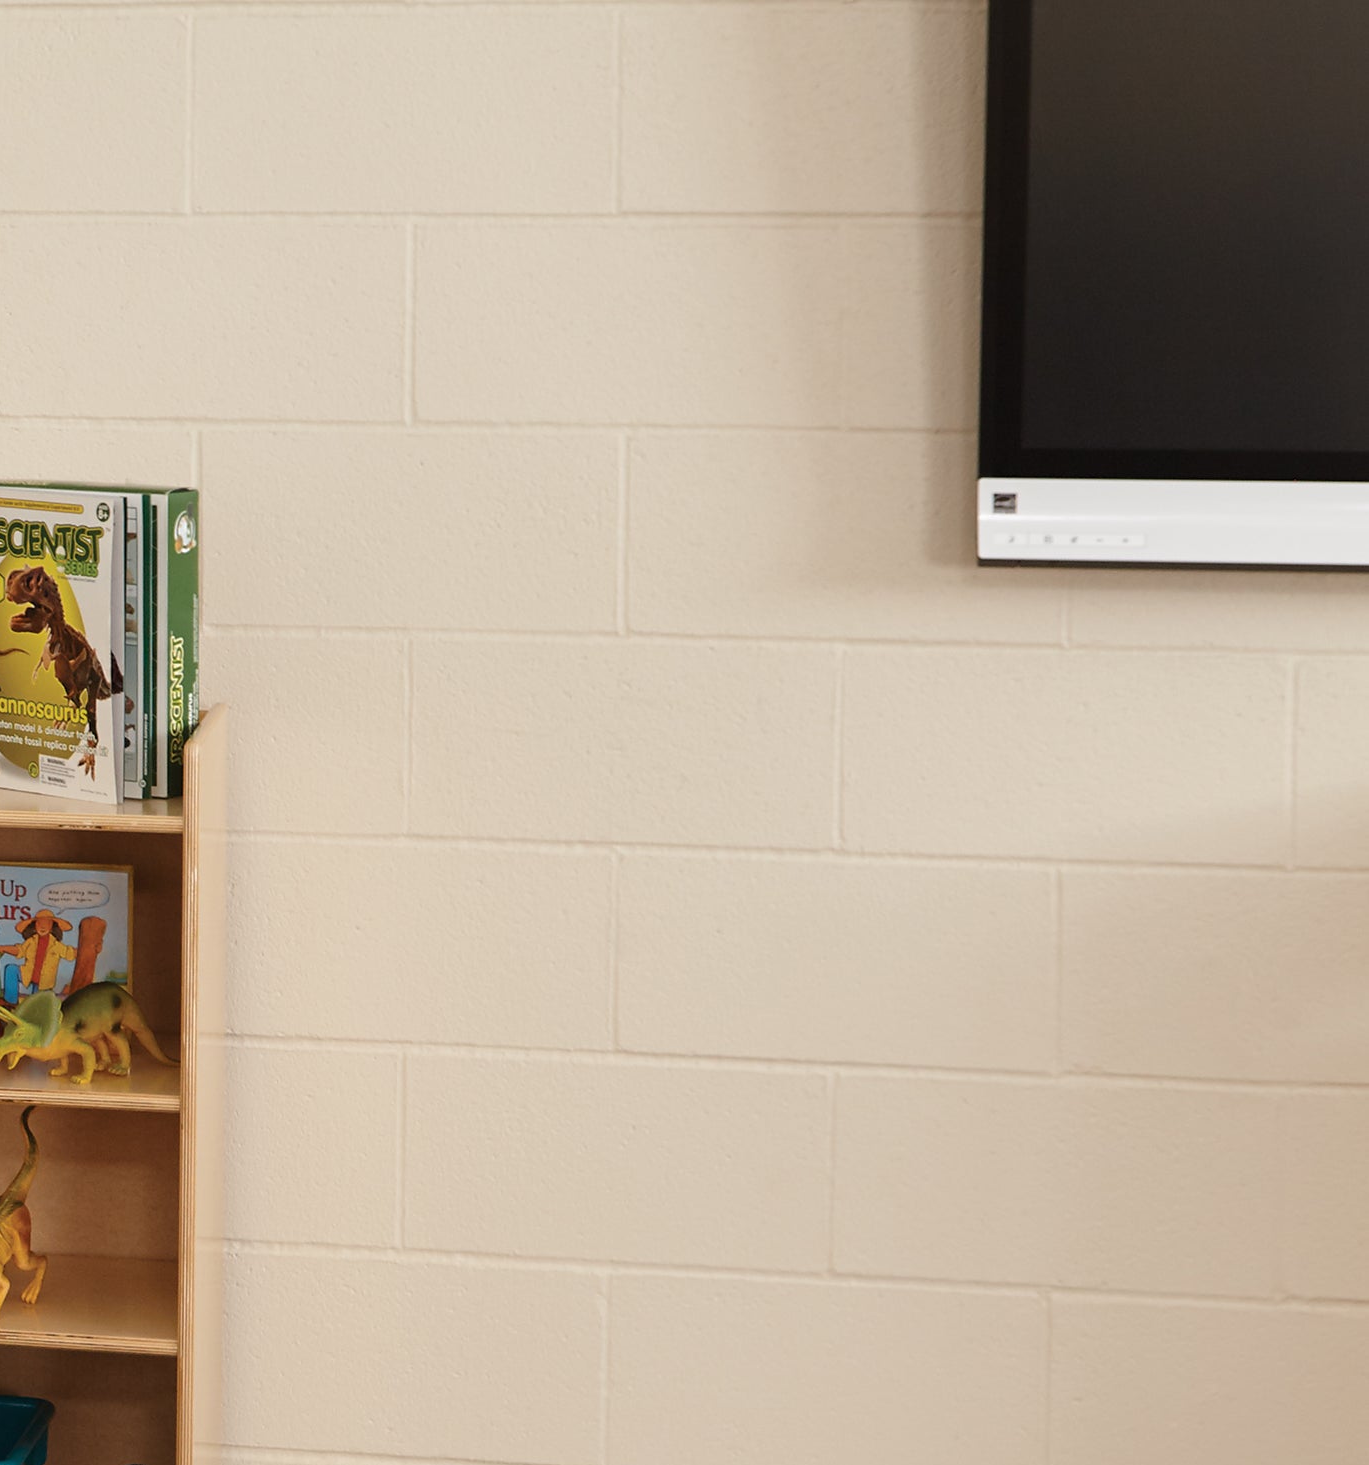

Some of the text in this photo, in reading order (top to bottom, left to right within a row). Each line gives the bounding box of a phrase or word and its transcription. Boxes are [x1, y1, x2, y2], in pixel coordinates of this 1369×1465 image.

[64, 561, 98, 578] SERIES
[169, 636, 184, 736] SCIENTIST
[14, 723, 36, 733] model
[45, 726, 74, 738] dinosaur
[24, 736, 42, 747] fossil
[44, 740, 67, 751] replica
[0, 880, 27, 900] Up
